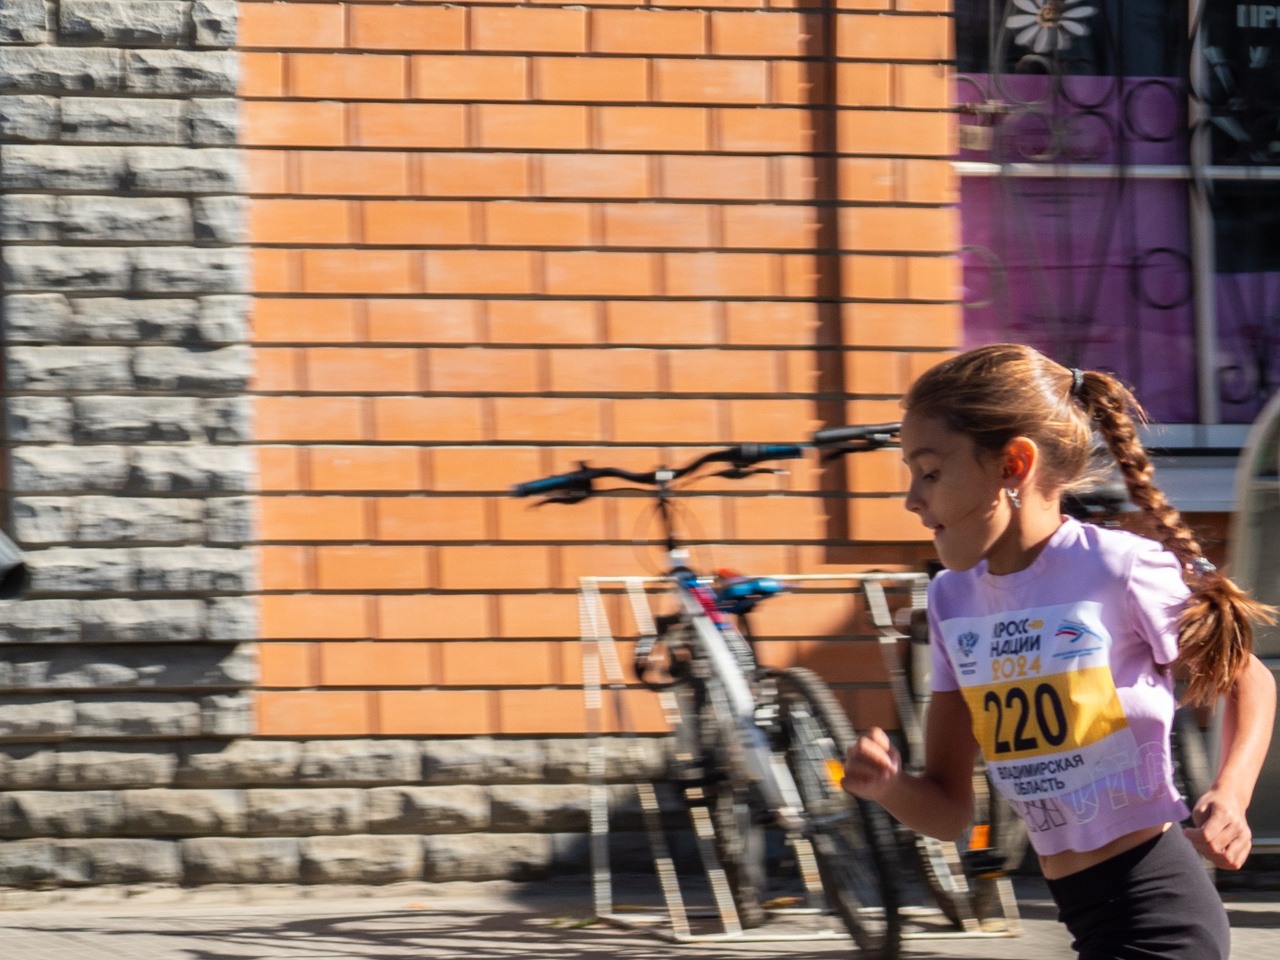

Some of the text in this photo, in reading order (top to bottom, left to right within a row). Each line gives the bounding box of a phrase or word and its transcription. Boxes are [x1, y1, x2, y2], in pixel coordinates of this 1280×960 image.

[989, 634, 1042, 657] НАЦИИ
[991, 653, 1043, 681] 2024
[983, 683, 1068, 754] 220
